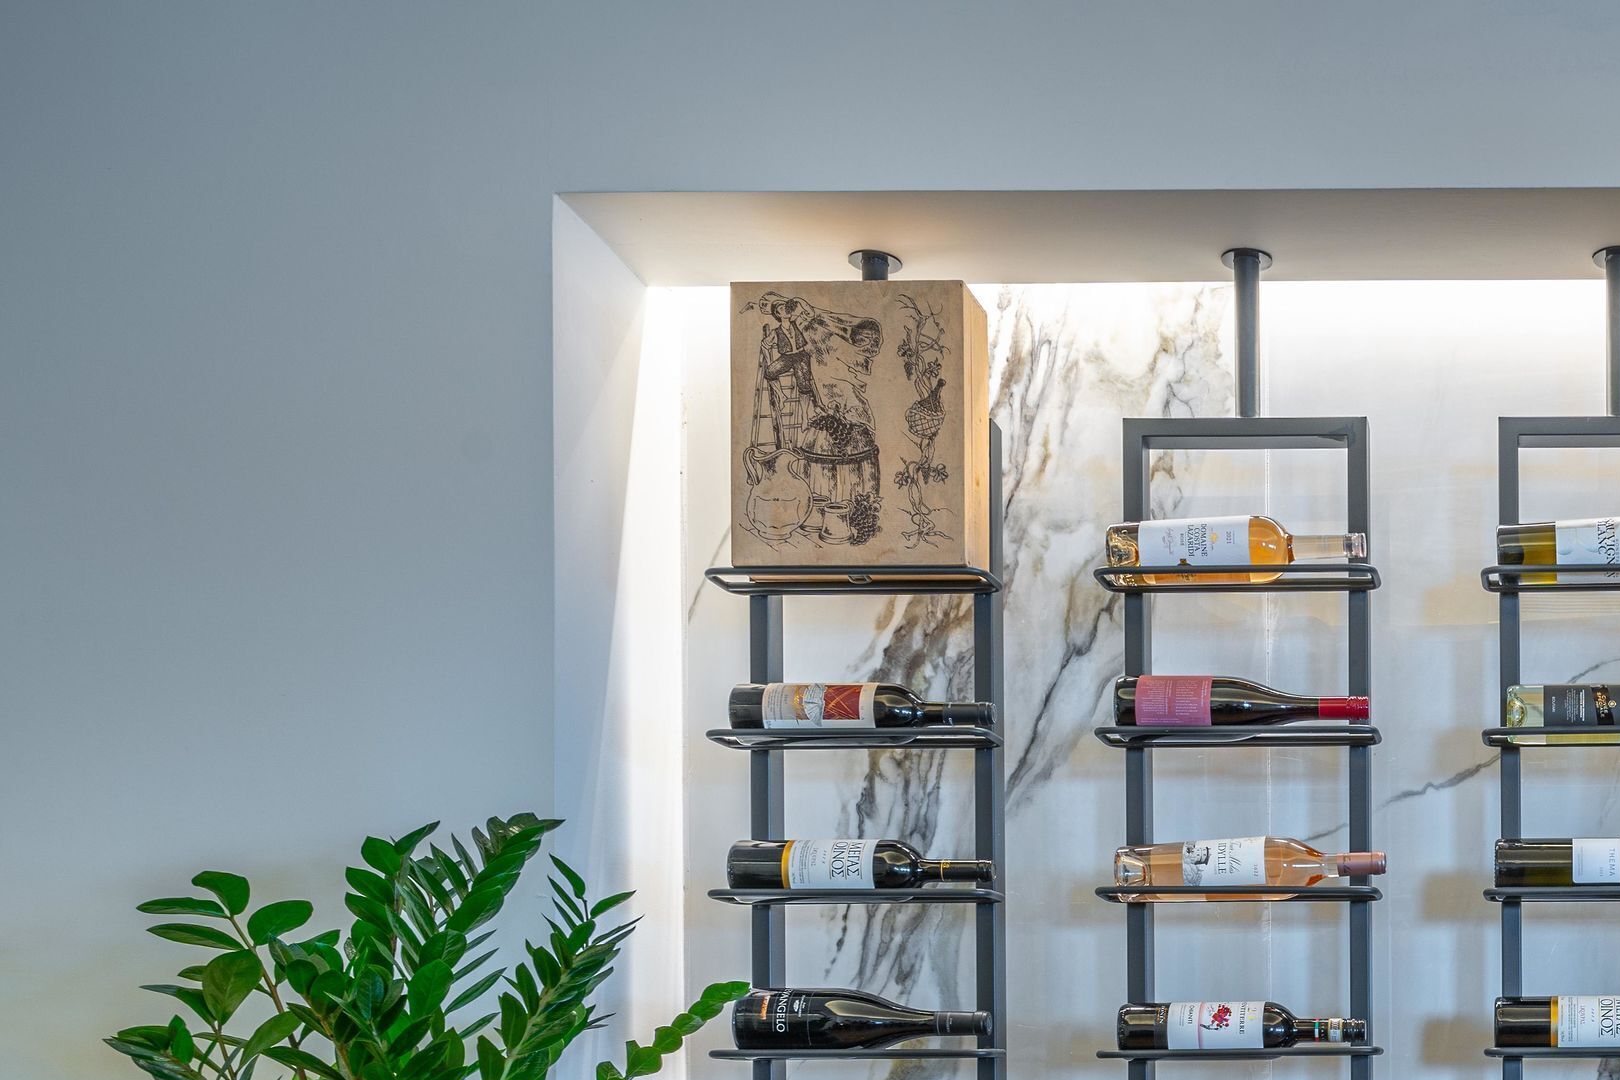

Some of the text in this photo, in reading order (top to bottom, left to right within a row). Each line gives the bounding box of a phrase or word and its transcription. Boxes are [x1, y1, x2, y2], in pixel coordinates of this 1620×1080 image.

[1187, 524, 1195, 557] LAZARIDI
[1200, 523, 1208, 557] DOMAINE
[1604, 518, 1616, 578] SAUVIGNN
[831, 842, 848, 878] ΟΙΝΟΣ
[847, 842, 862, 876] ΜΕΓΑΣ
[1217, 843, 1227, 874] IDYLLE
[1187, 1005, 1195, 1024] CHIANTI
[1600, 998, 1614, 1036] ΟΙΝΟΣ
